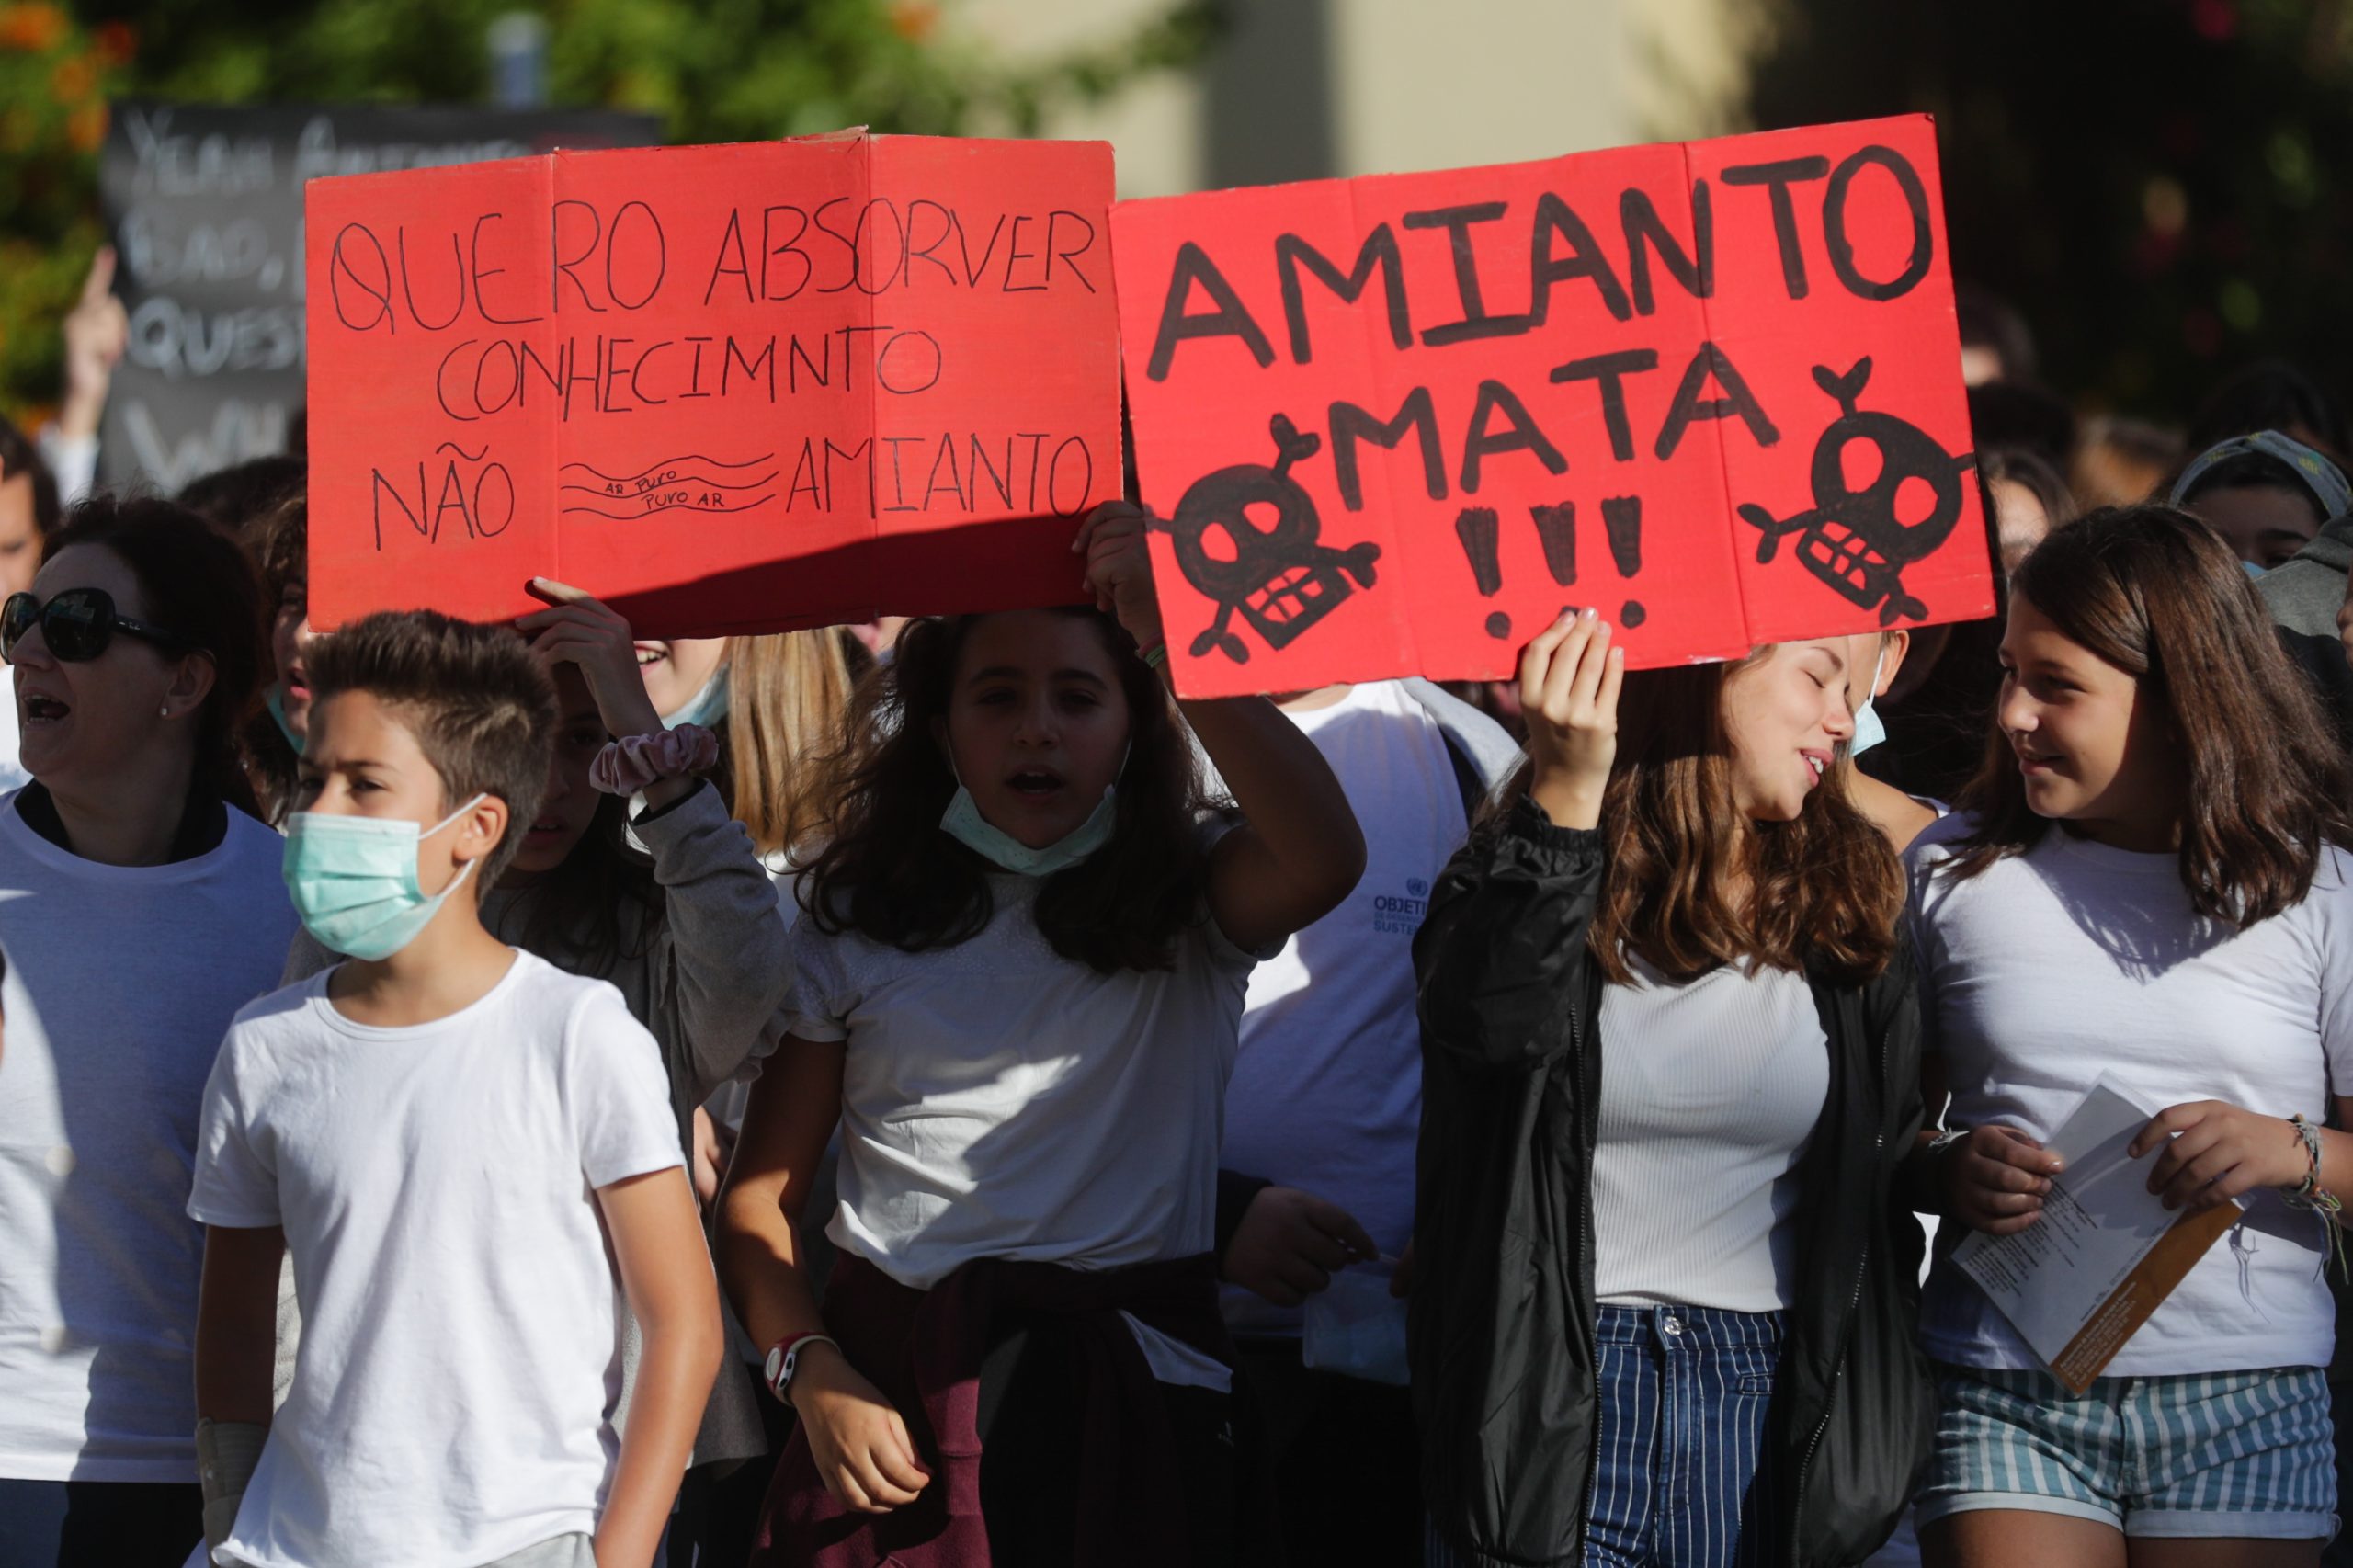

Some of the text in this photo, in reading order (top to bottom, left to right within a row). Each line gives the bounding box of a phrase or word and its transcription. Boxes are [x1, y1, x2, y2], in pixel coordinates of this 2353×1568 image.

[330, 198, 1096, 335] QUERO ABSORVER
[1147, 144, 1933, 381] AMIANTO
[437, 326, 941, 422] CONHECIMNTO
[1328, 341, 1781, 512] MATA
[371, 432, 1092, 551] NÃO AMIANTO
[605, 483, 624, 494] AR
[697, 492, 724, 507] AR
